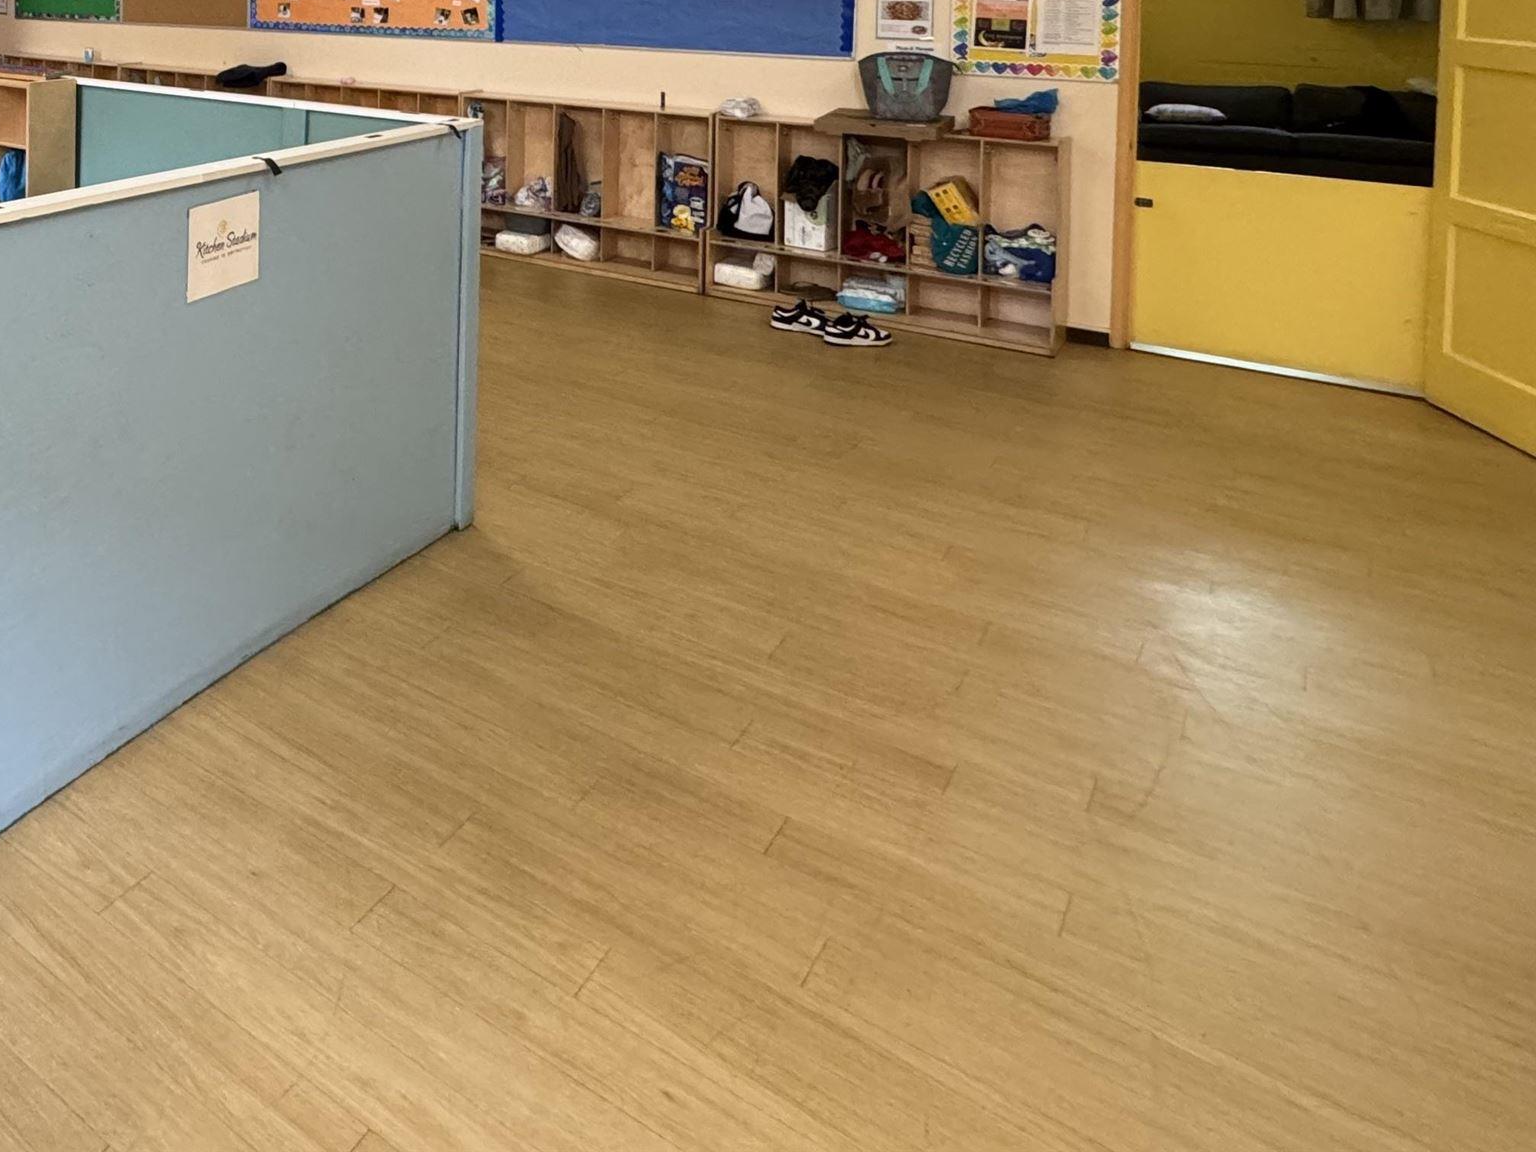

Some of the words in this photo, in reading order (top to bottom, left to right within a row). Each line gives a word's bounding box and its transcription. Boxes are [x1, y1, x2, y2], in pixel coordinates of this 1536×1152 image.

[195, 236, 225, 259] Kitchen
[226, 228, 257, 248] Stadium
[943, 229, 972, 267] RECYCLED
